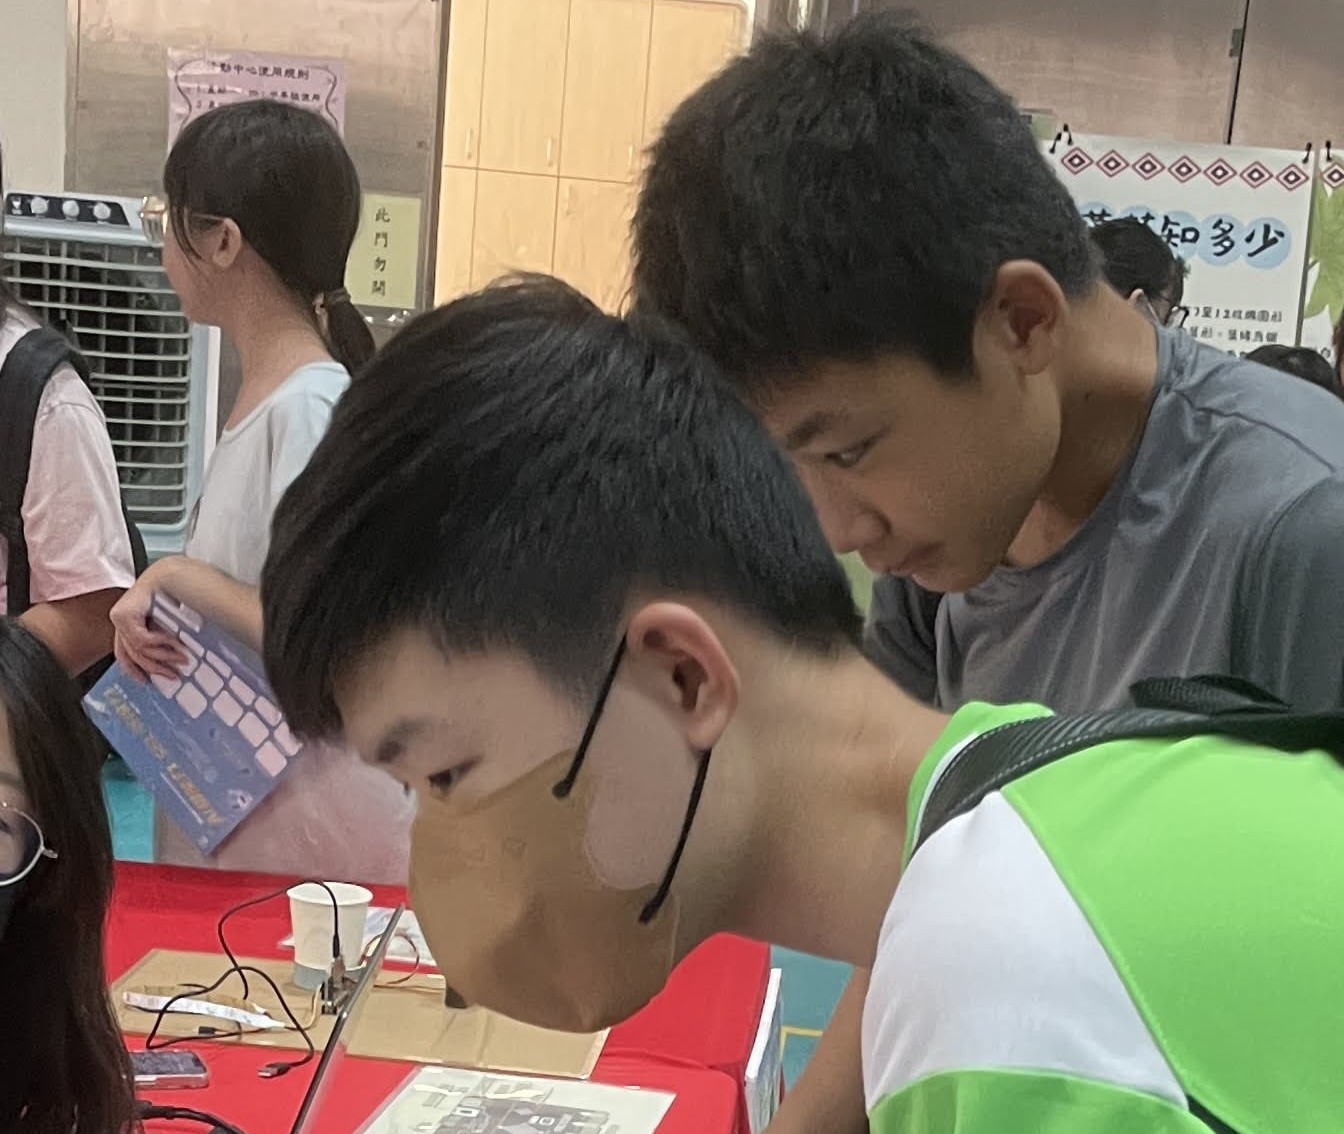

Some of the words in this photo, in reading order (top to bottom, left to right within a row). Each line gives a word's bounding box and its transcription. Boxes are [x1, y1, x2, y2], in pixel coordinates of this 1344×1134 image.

[209, 61, 309, 80] 動中心使用規則
